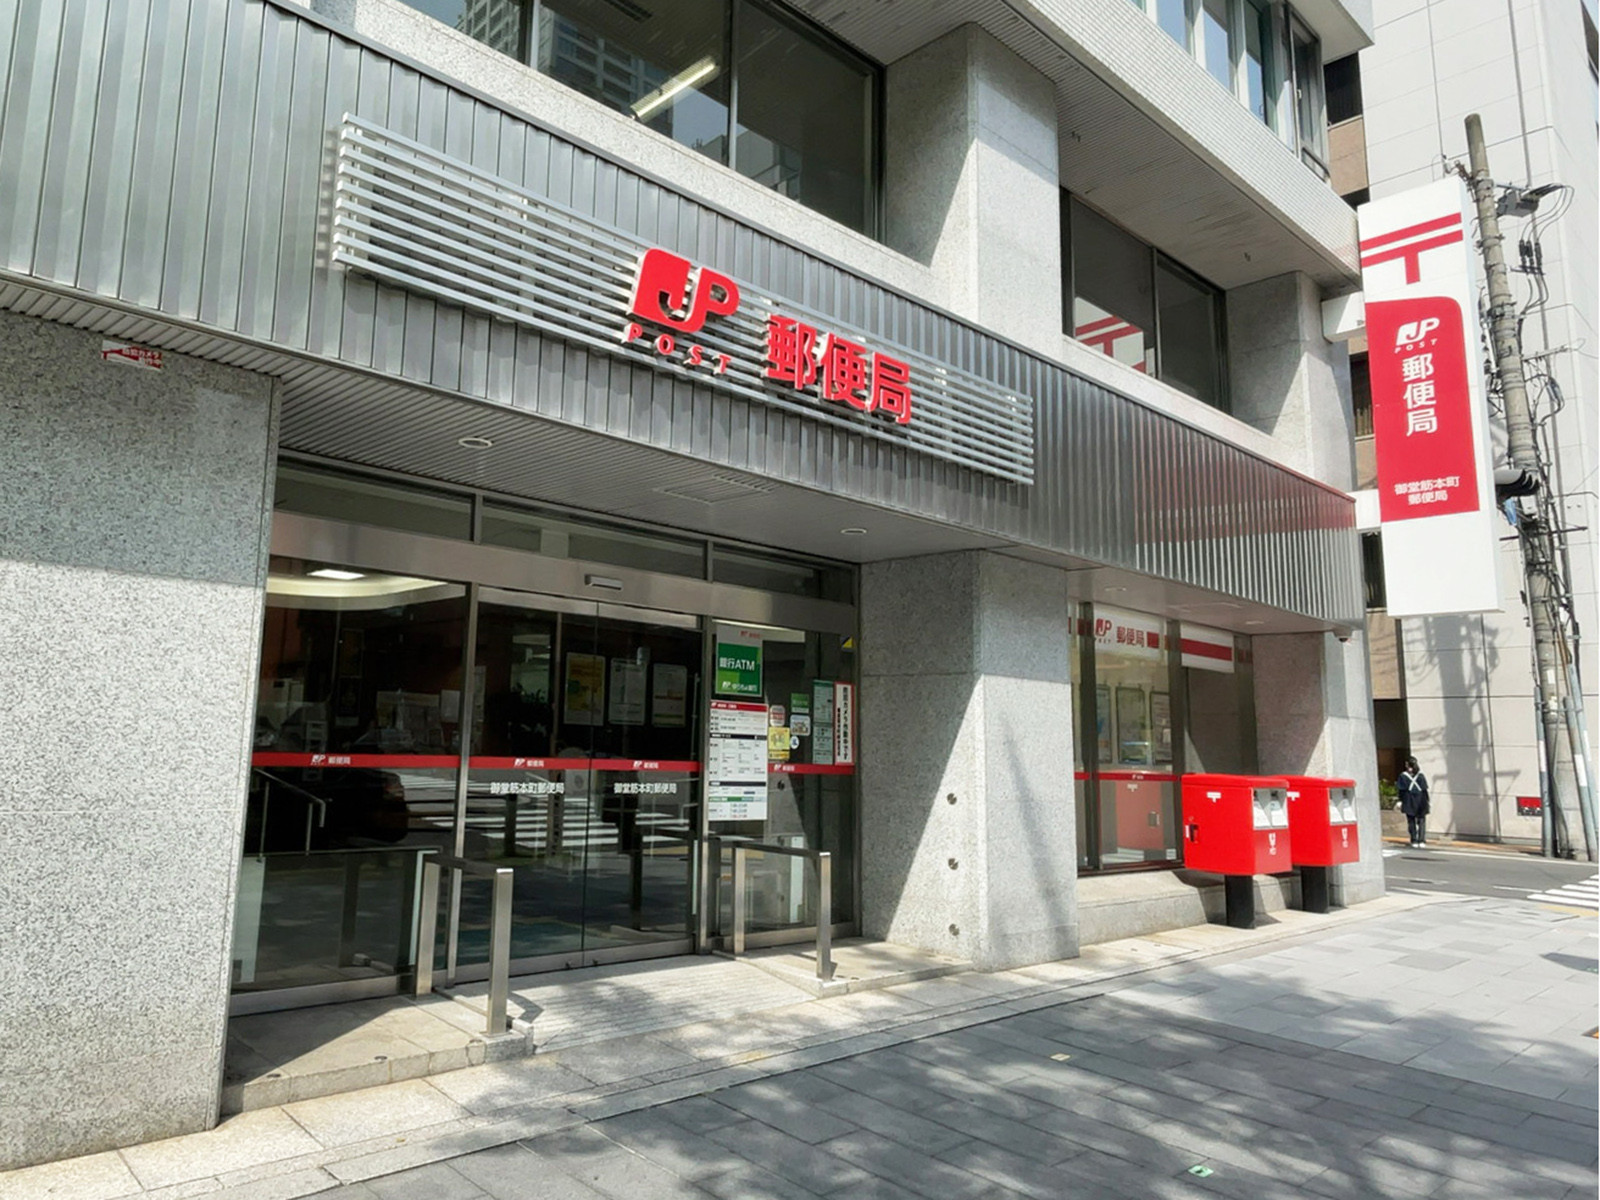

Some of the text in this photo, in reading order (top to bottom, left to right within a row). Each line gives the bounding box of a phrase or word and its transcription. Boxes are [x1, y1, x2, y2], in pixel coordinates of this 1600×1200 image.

[631, 248, 740, 333] JP
[1395, 317, 1440, 346] JP
[624, 322, 731, 374] POST
[1394, 338, 1438, 354] POST
[764, 313, 912, 425] 郵便局
[1403, 353, 1438, 437] 郵便局
[1394, 476, 1460, 496] 御堂筋本町
[1408, 490, 1448, 505] 郵便局
[1117, 626, 1145, 648] 郵便局
[720, 657, 755, 671] 銀行ATM
[490, 782, 565, 794] 御堂筋本町郵便局
[614, 783, 677, 794] 御堂筋本町郵便局
